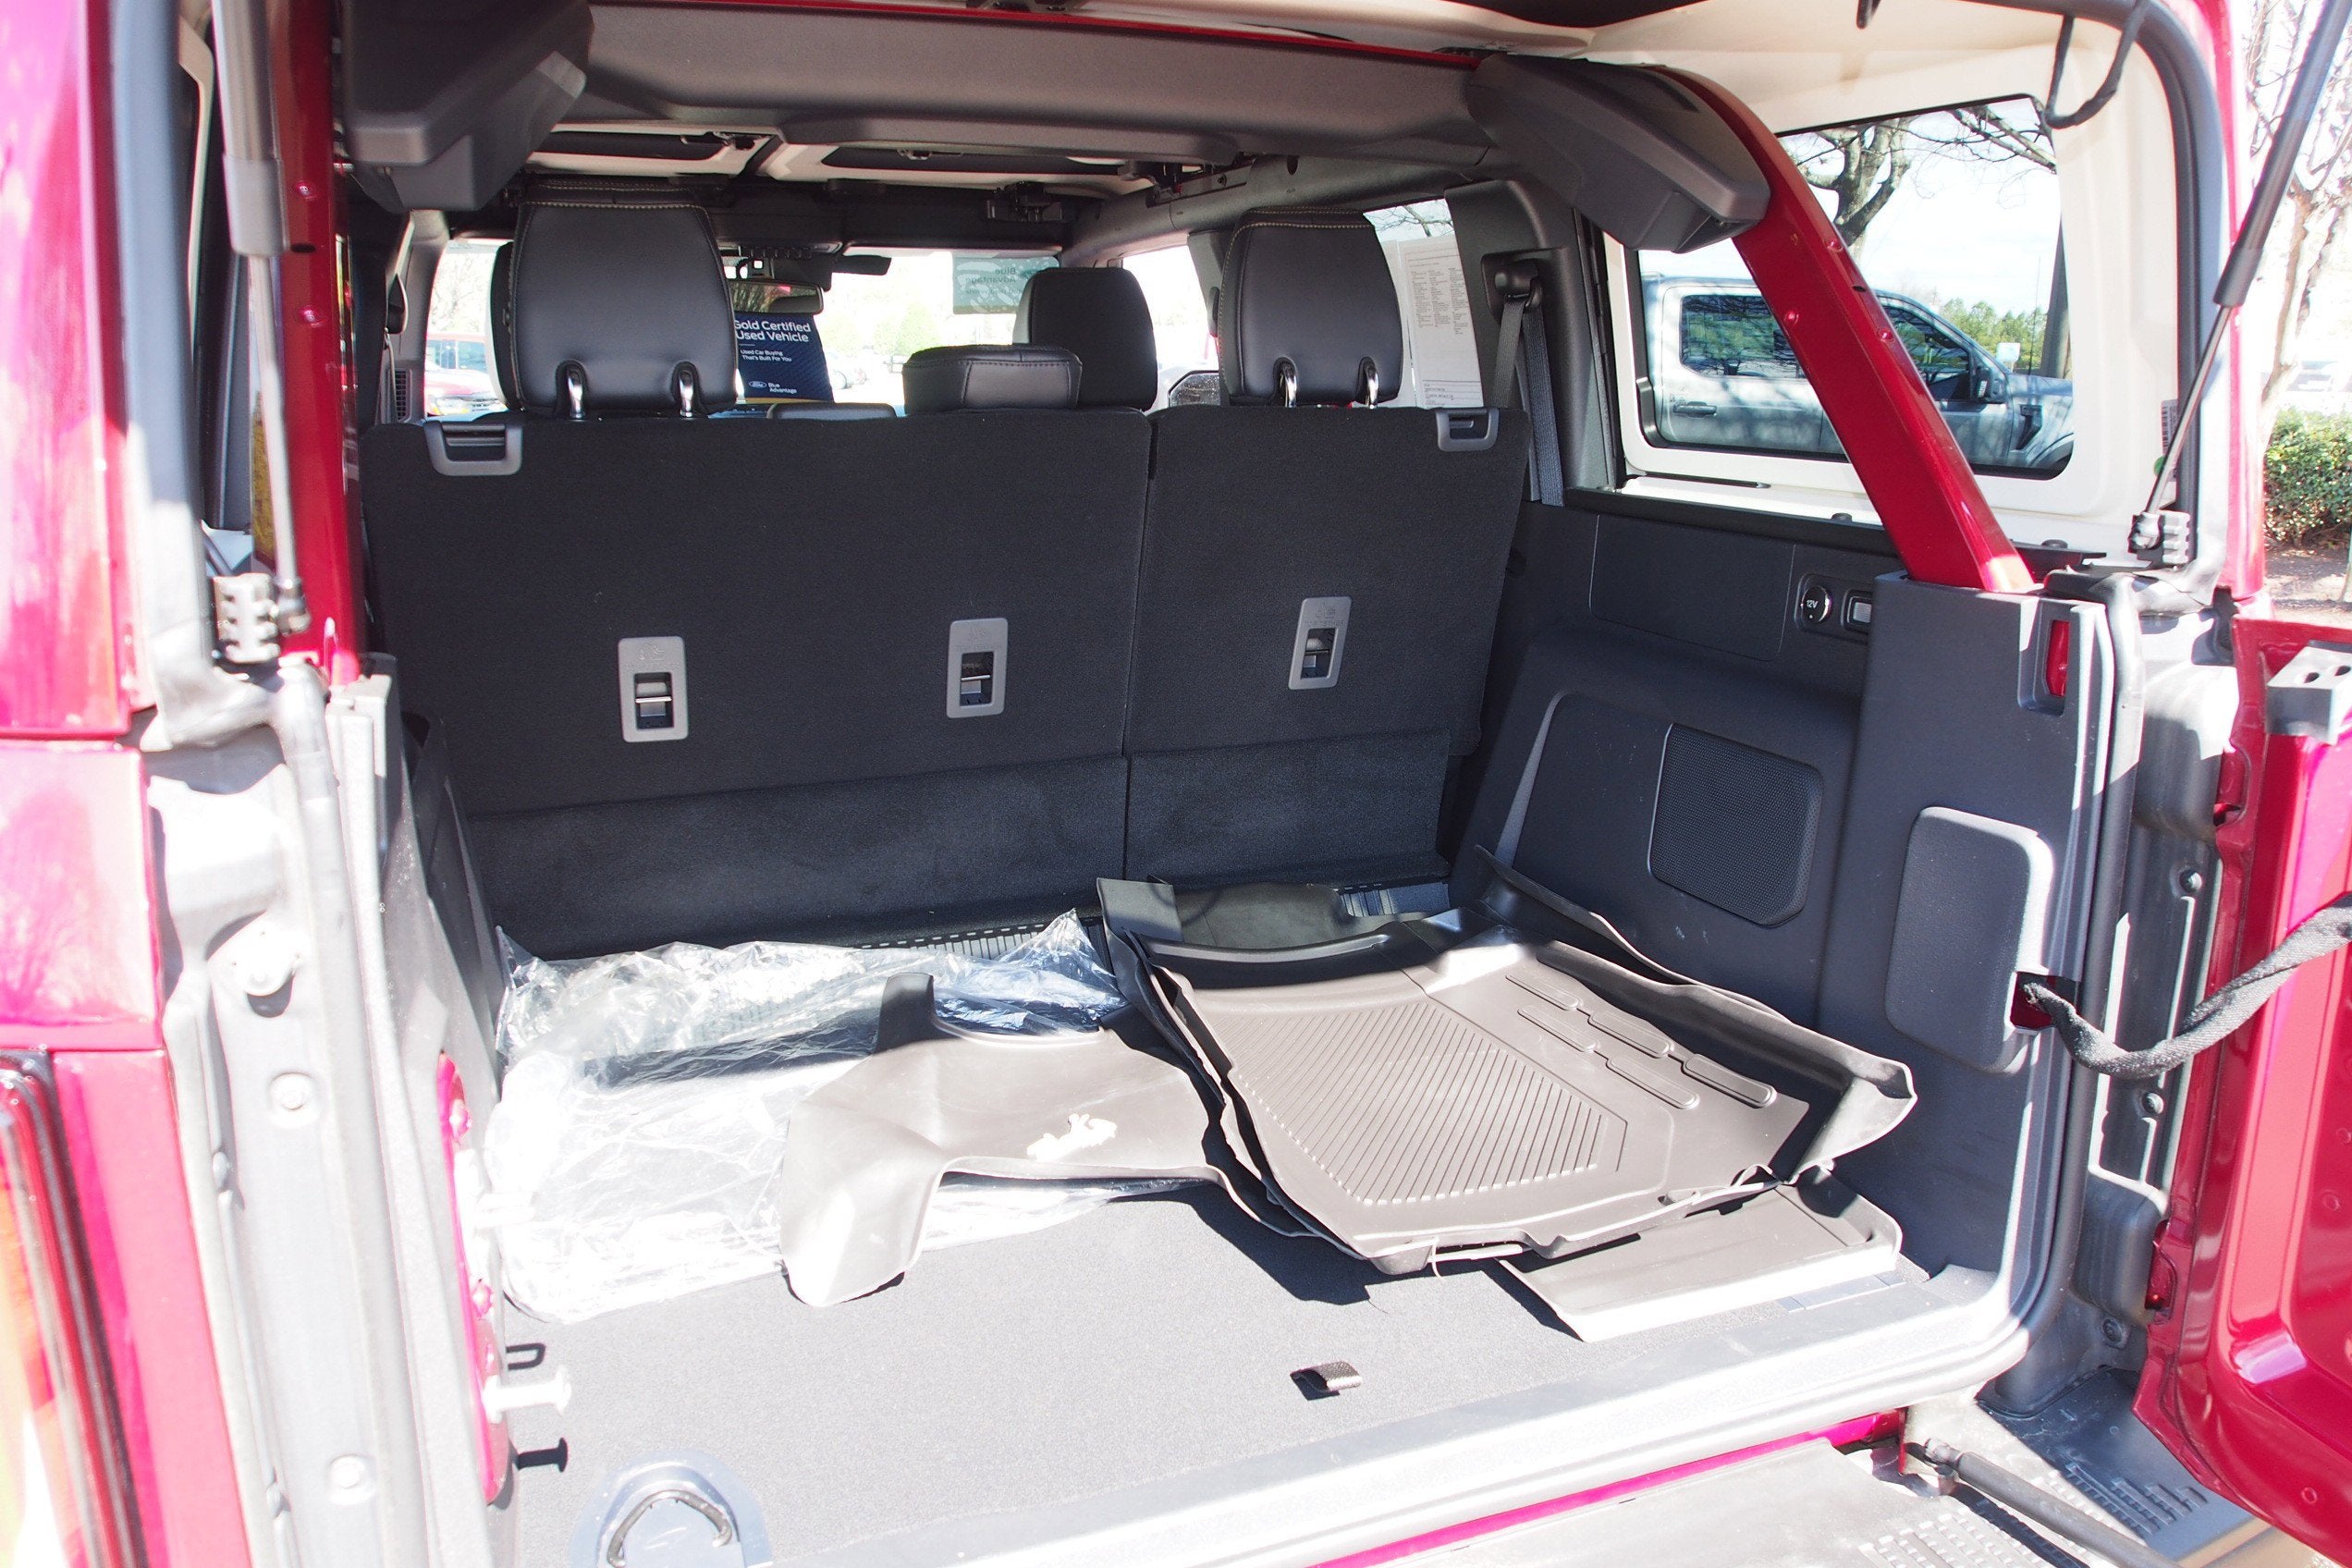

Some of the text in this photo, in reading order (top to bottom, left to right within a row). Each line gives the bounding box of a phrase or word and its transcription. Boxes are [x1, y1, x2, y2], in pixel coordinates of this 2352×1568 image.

[734, 320, 812, 332] Gold Certified
[735, 330, 809, 342] Used Vehicle
[1807, 600, 1819, 608] 12V
